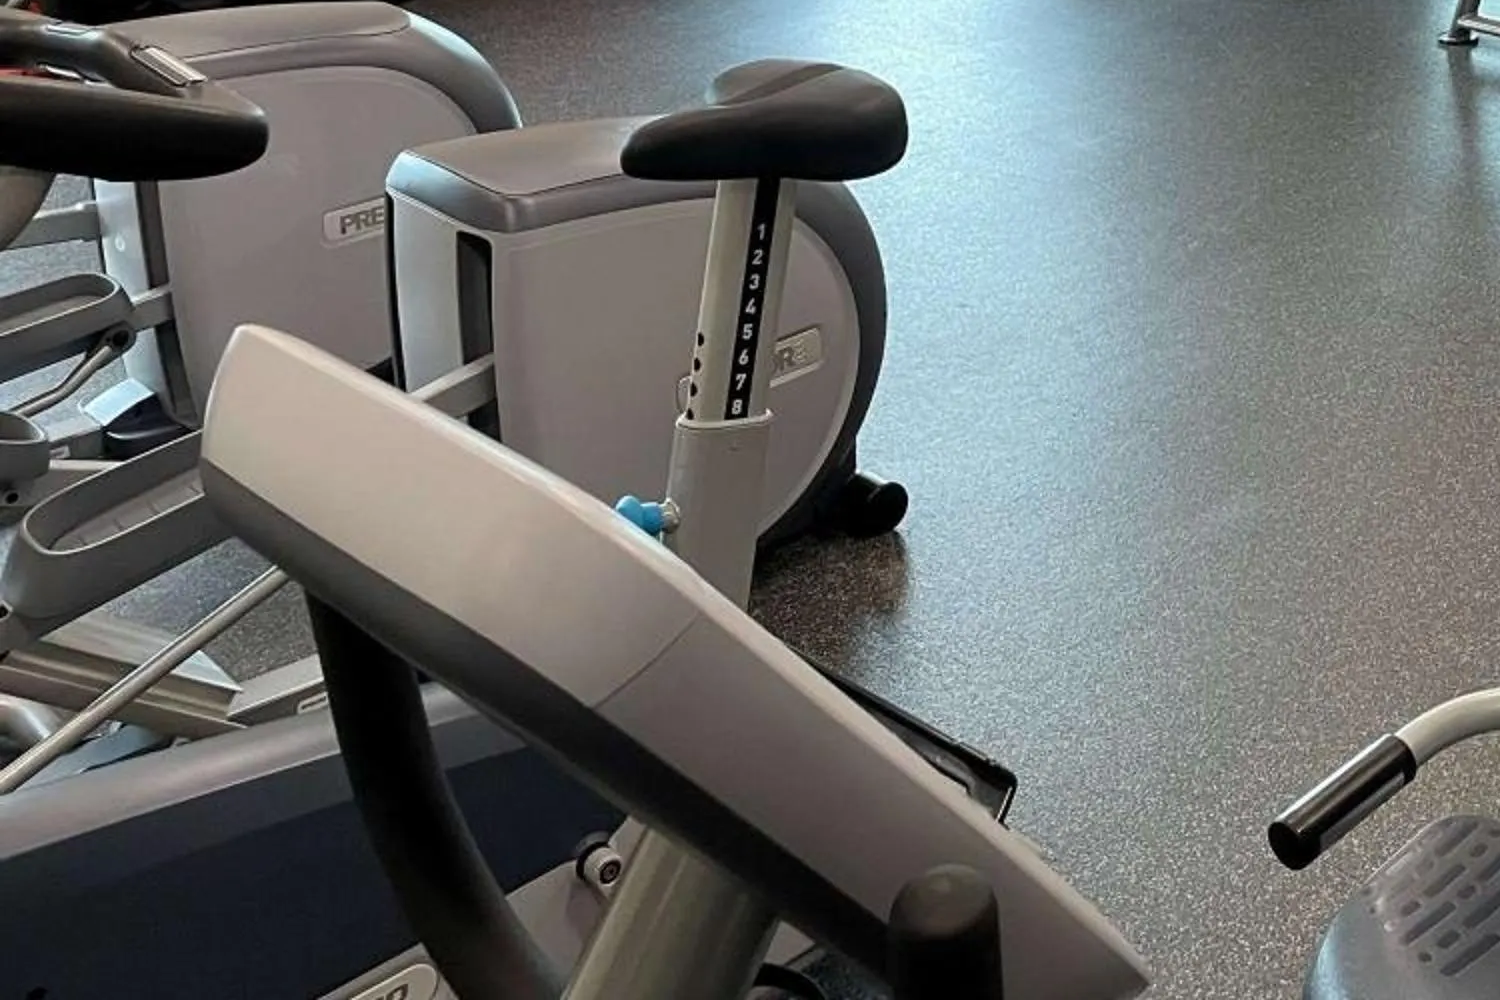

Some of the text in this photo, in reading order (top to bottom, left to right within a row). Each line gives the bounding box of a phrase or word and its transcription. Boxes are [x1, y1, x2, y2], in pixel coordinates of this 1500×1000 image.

[757, 223, 766, 240] 1
[751, 250, 763, 265] 2
[749, 274, 760, 290] 3
[742, 323, 753, 339] 5
[738, 350, 749, 365] 6
[735, 374, 747, 390] 7
[731, 399, 742, 415] 8
